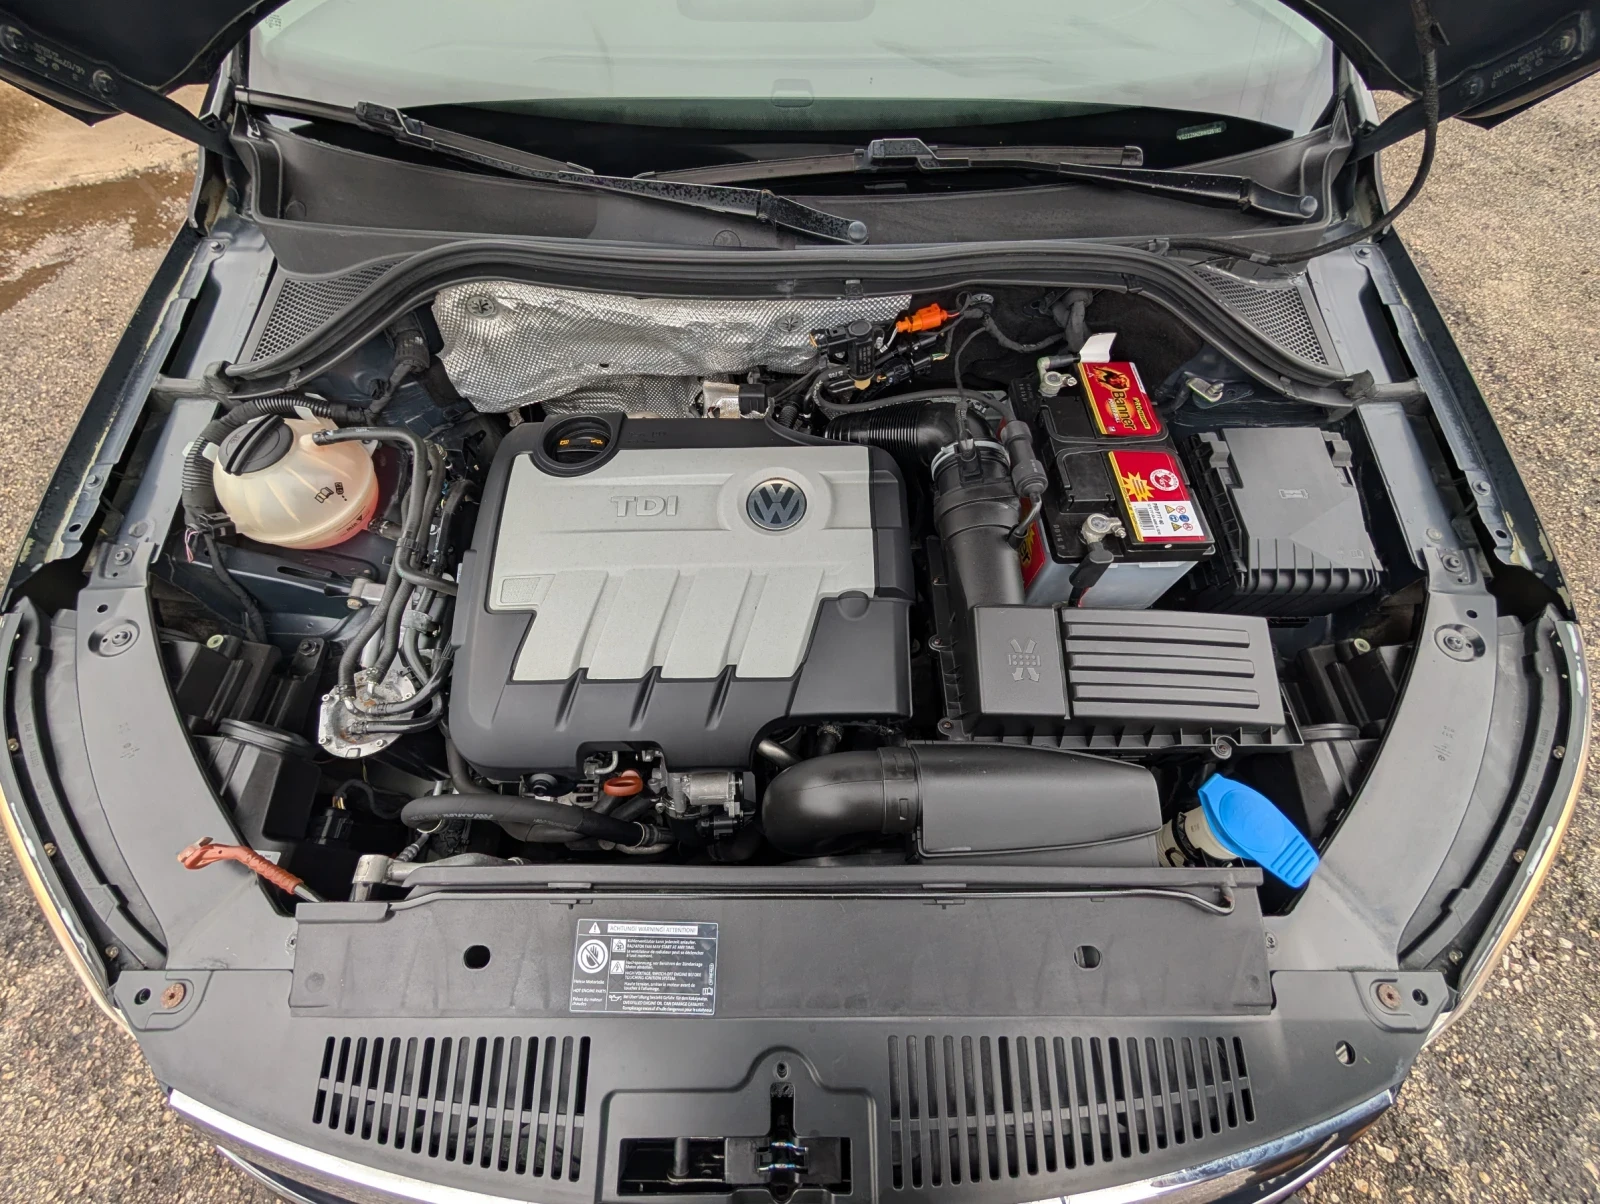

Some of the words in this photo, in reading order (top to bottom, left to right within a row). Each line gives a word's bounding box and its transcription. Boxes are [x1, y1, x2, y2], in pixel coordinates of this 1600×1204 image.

[1112, 391, 1137, 430] Banner
[611, 496, 679, 518] TDI
[346, 522, 358, 532] min
